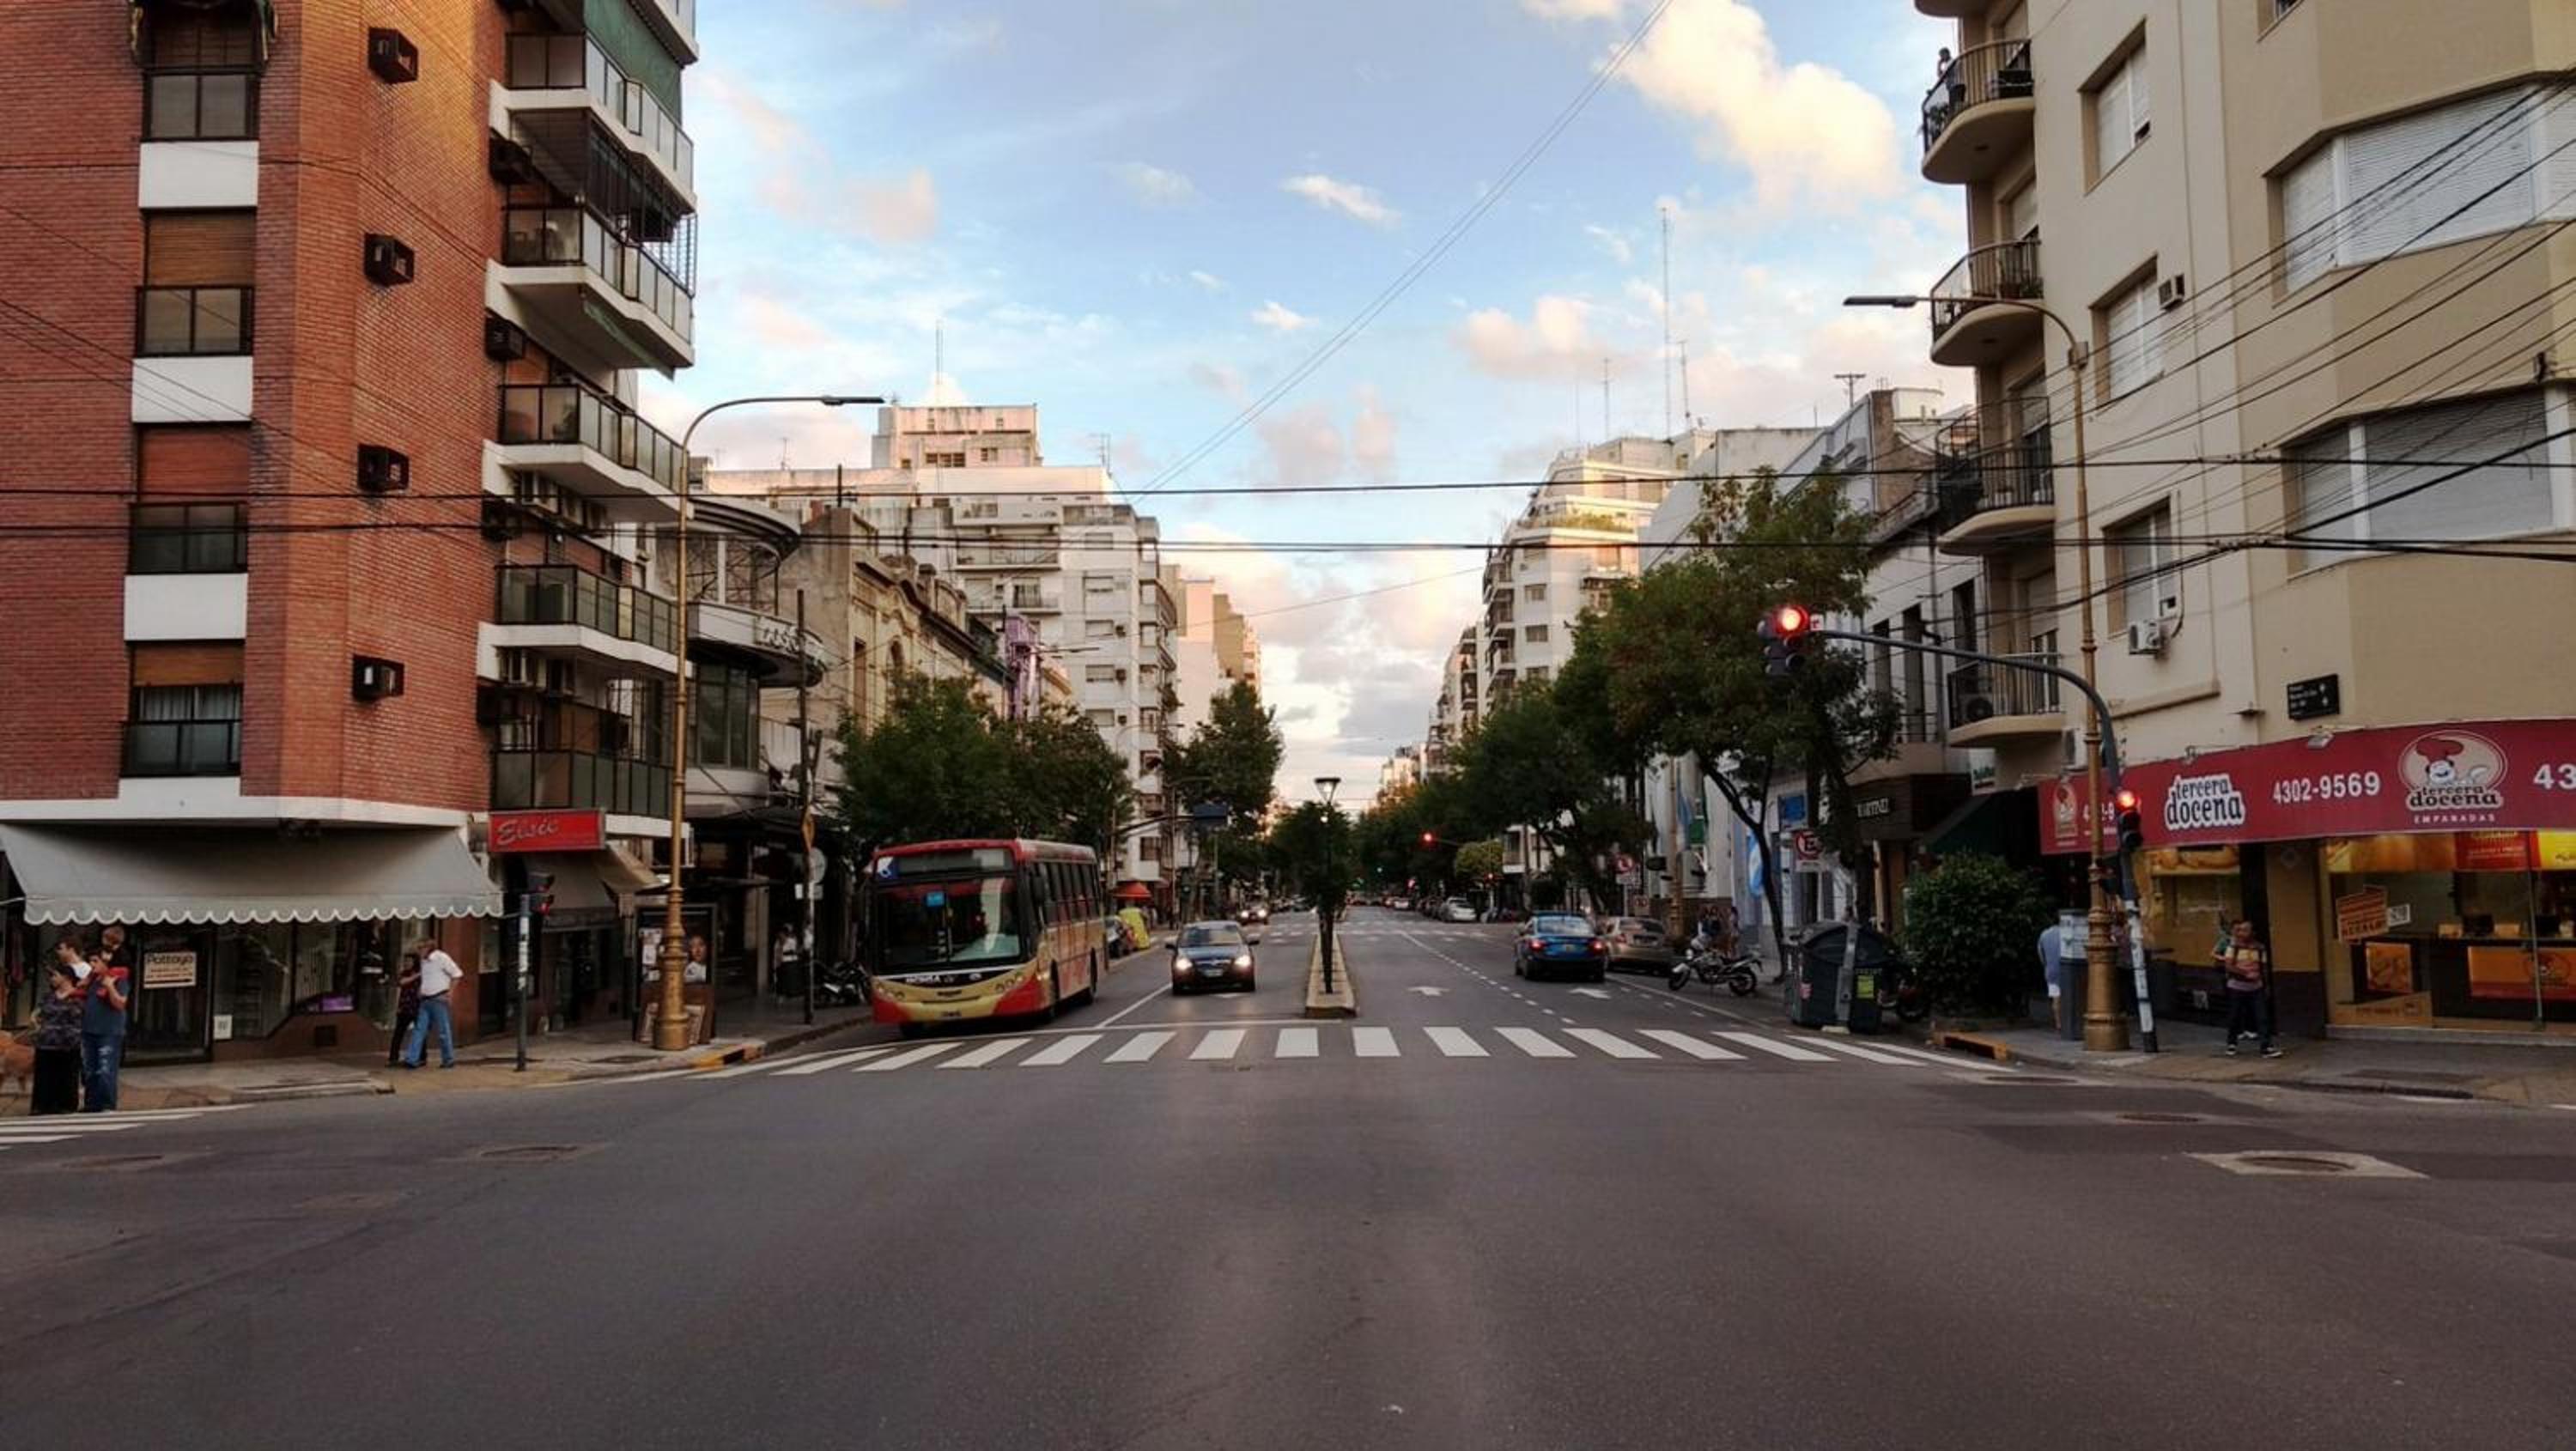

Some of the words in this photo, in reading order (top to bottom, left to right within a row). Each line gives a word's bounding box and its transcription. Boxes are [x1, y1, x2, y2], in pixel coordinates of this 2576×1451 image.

[2272, 771, 2381, 804] 4302-9569
[2533, 763, 2576, 790] 43
[2176, 778, 2230, 800] tercera
[2409, 791, 2499, 807] docena
[2421, 785, 2484, 796] tercera
[2166, 789, 2242, 825] docena
